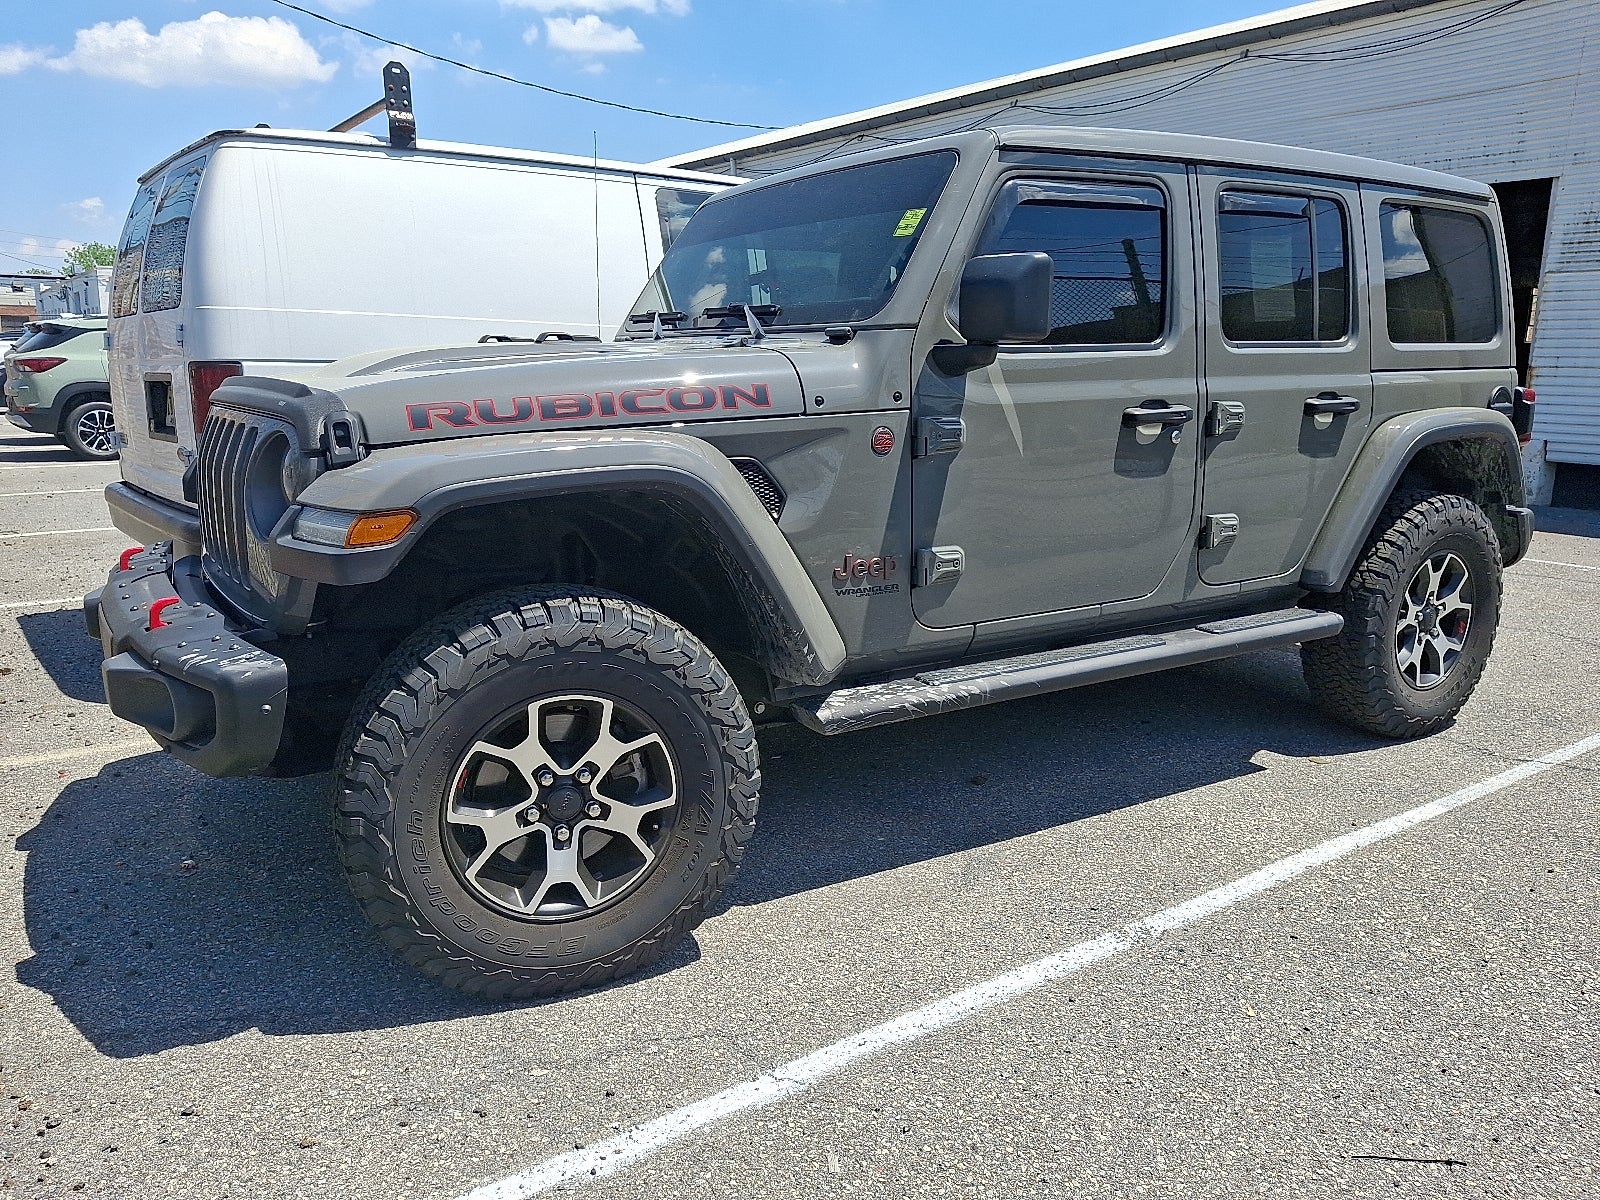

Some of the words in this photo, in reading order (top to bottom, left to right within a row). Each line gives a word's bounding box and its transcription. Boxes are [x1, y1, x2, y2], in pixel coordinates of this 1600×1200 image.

[405, 383, 772, 431] RUBICON
[832, 552, 897, 580] Jeep
[834, 583, 900, 597] WRANGLER
